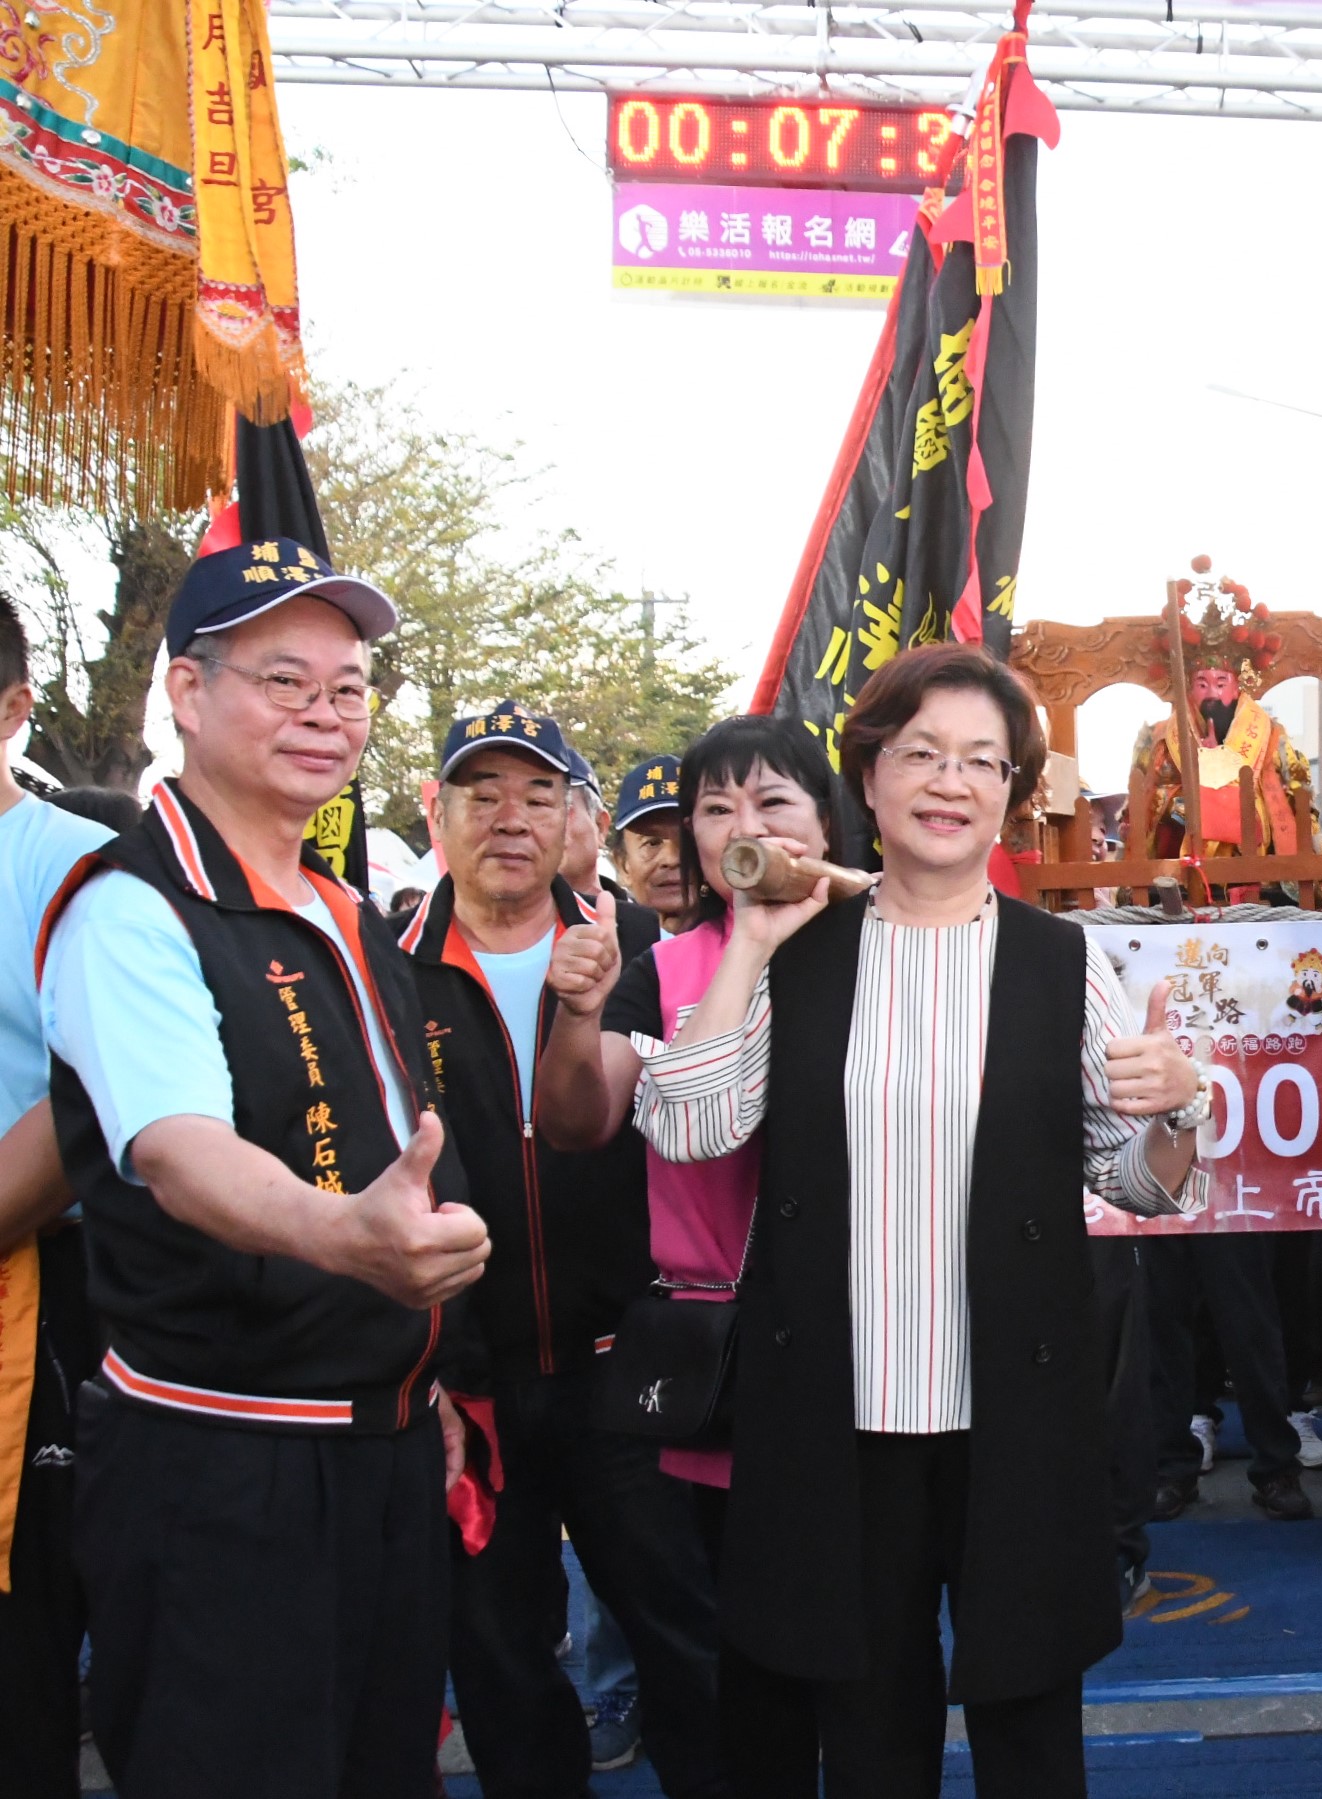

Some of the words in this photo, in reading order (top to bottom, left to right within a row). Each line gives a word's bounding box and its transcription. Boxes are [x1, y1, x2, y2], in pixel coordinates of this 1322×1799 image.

[678, 209, 876, 251] 樂活報名網
